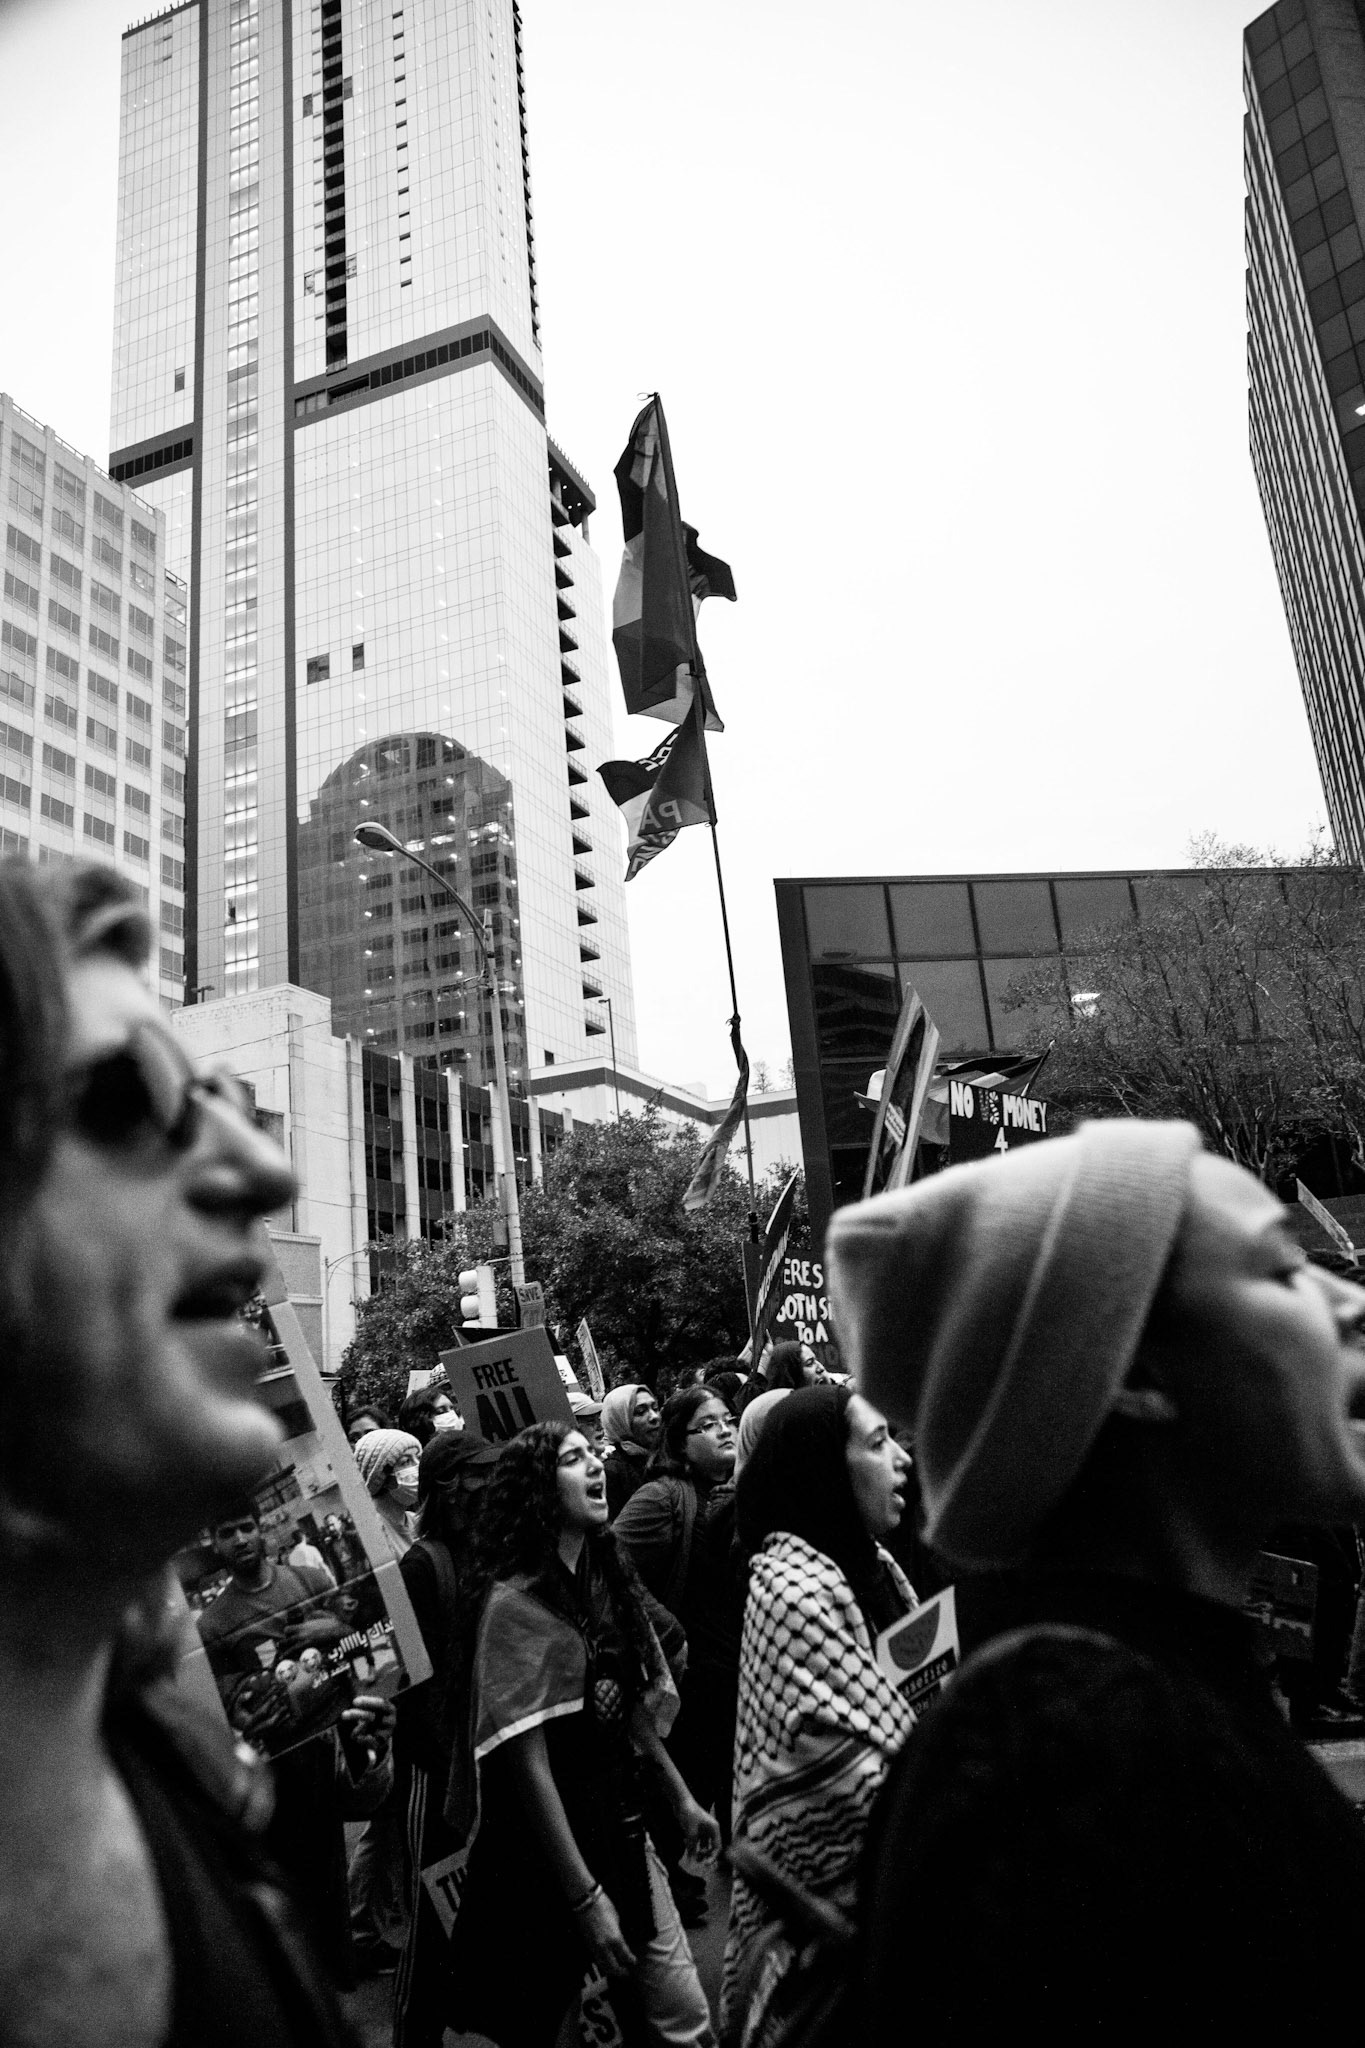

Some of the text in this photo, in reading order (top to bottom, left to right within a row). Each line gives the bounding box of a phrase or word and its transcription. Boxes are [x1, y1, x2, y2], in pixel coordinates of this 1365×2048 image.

[950, 1080, 974, 1119] NO
[1002, 1093, 1047, 1132] MONEY
[994, 1126, 1008, 1154] 4
[783, 1258, 824, 1289] ERES
[815, 1321, 829, 1343] A
[470, 1357, 519, 1390] FREE
